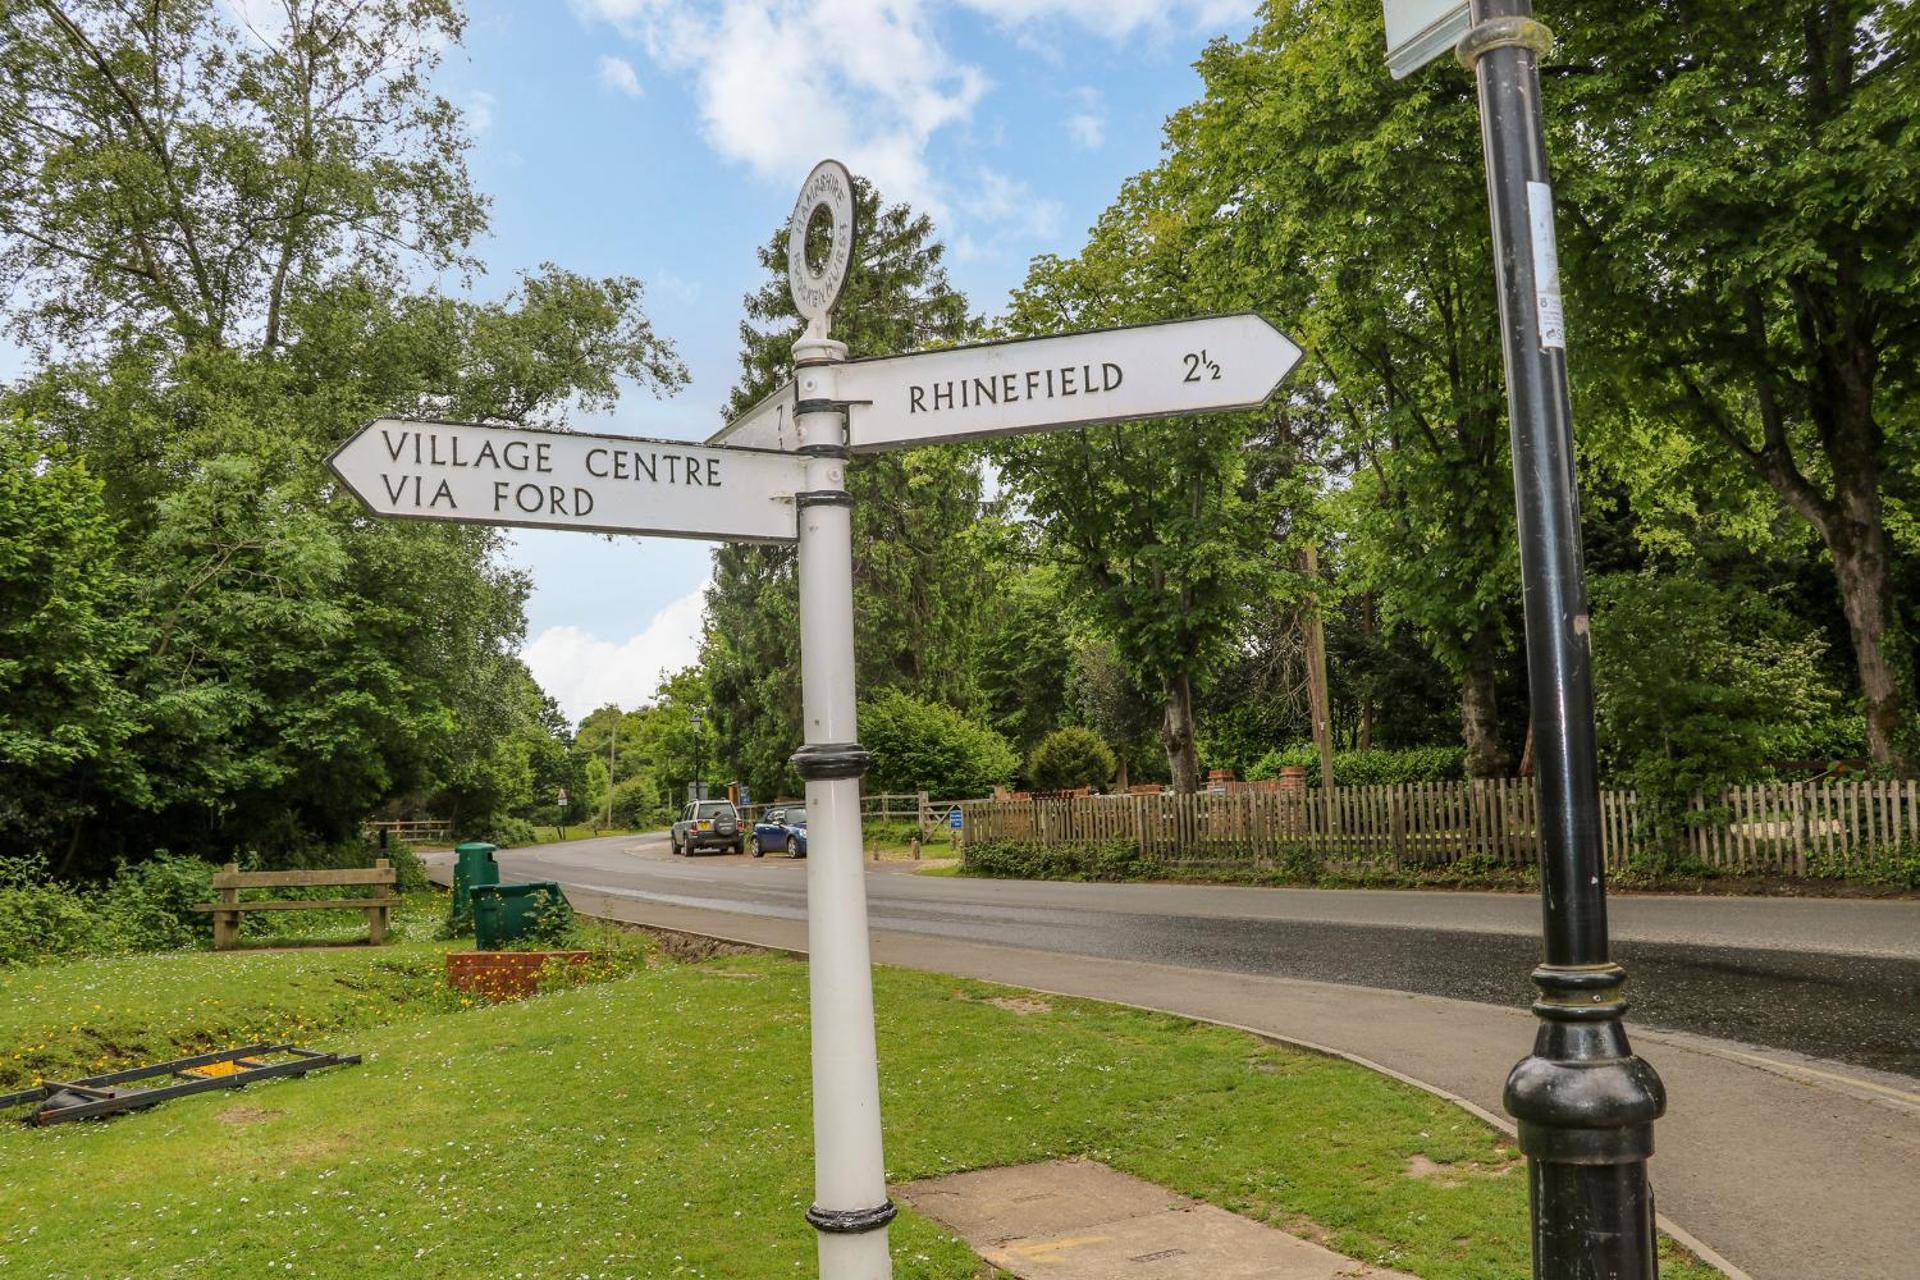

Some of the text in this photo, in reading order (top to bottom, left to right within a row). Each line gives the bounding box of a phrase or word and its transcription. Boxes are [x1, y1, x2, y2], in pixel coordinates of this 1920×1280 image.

[796, 172, 845, 234] HAMPSHIRE
[909, 362, 1123, 414] RHINEFIELD
[381, 430, 722, 487] VILLAGE CENTRE
[381, 473, 594, 517] VIA FORD
